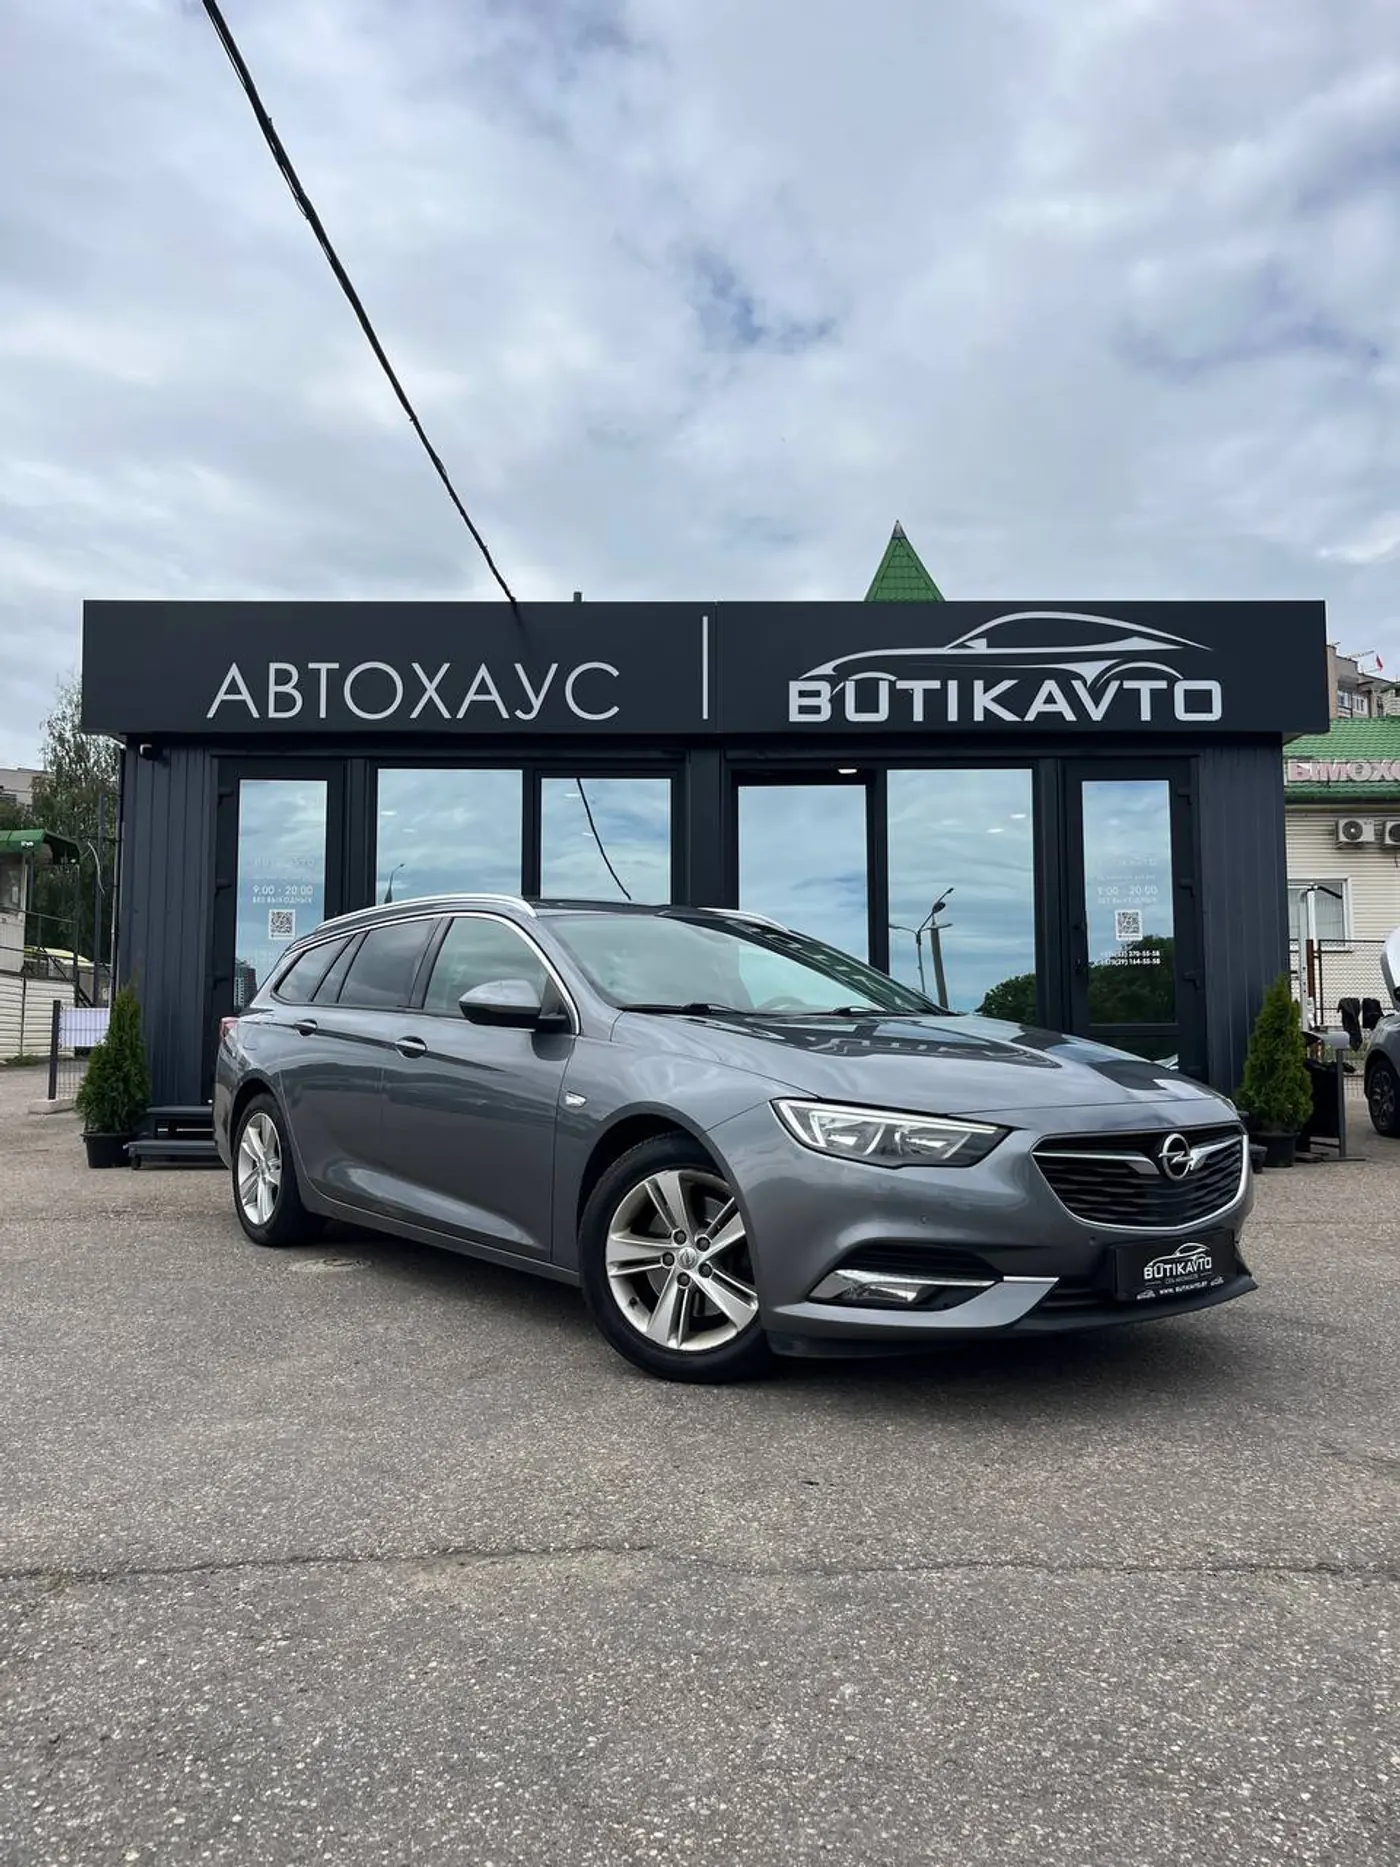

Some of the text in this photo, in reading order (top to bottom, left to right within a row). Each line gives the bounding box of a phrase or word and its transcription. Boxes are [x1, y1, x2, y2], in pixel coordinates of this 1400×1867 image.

[206, 661, 621, 721] АВТОХАУС
[788, 679, 1223, 722] BUTIKAVTO
[1143, 1256, 1212, 1280] BUTIKAVTO
